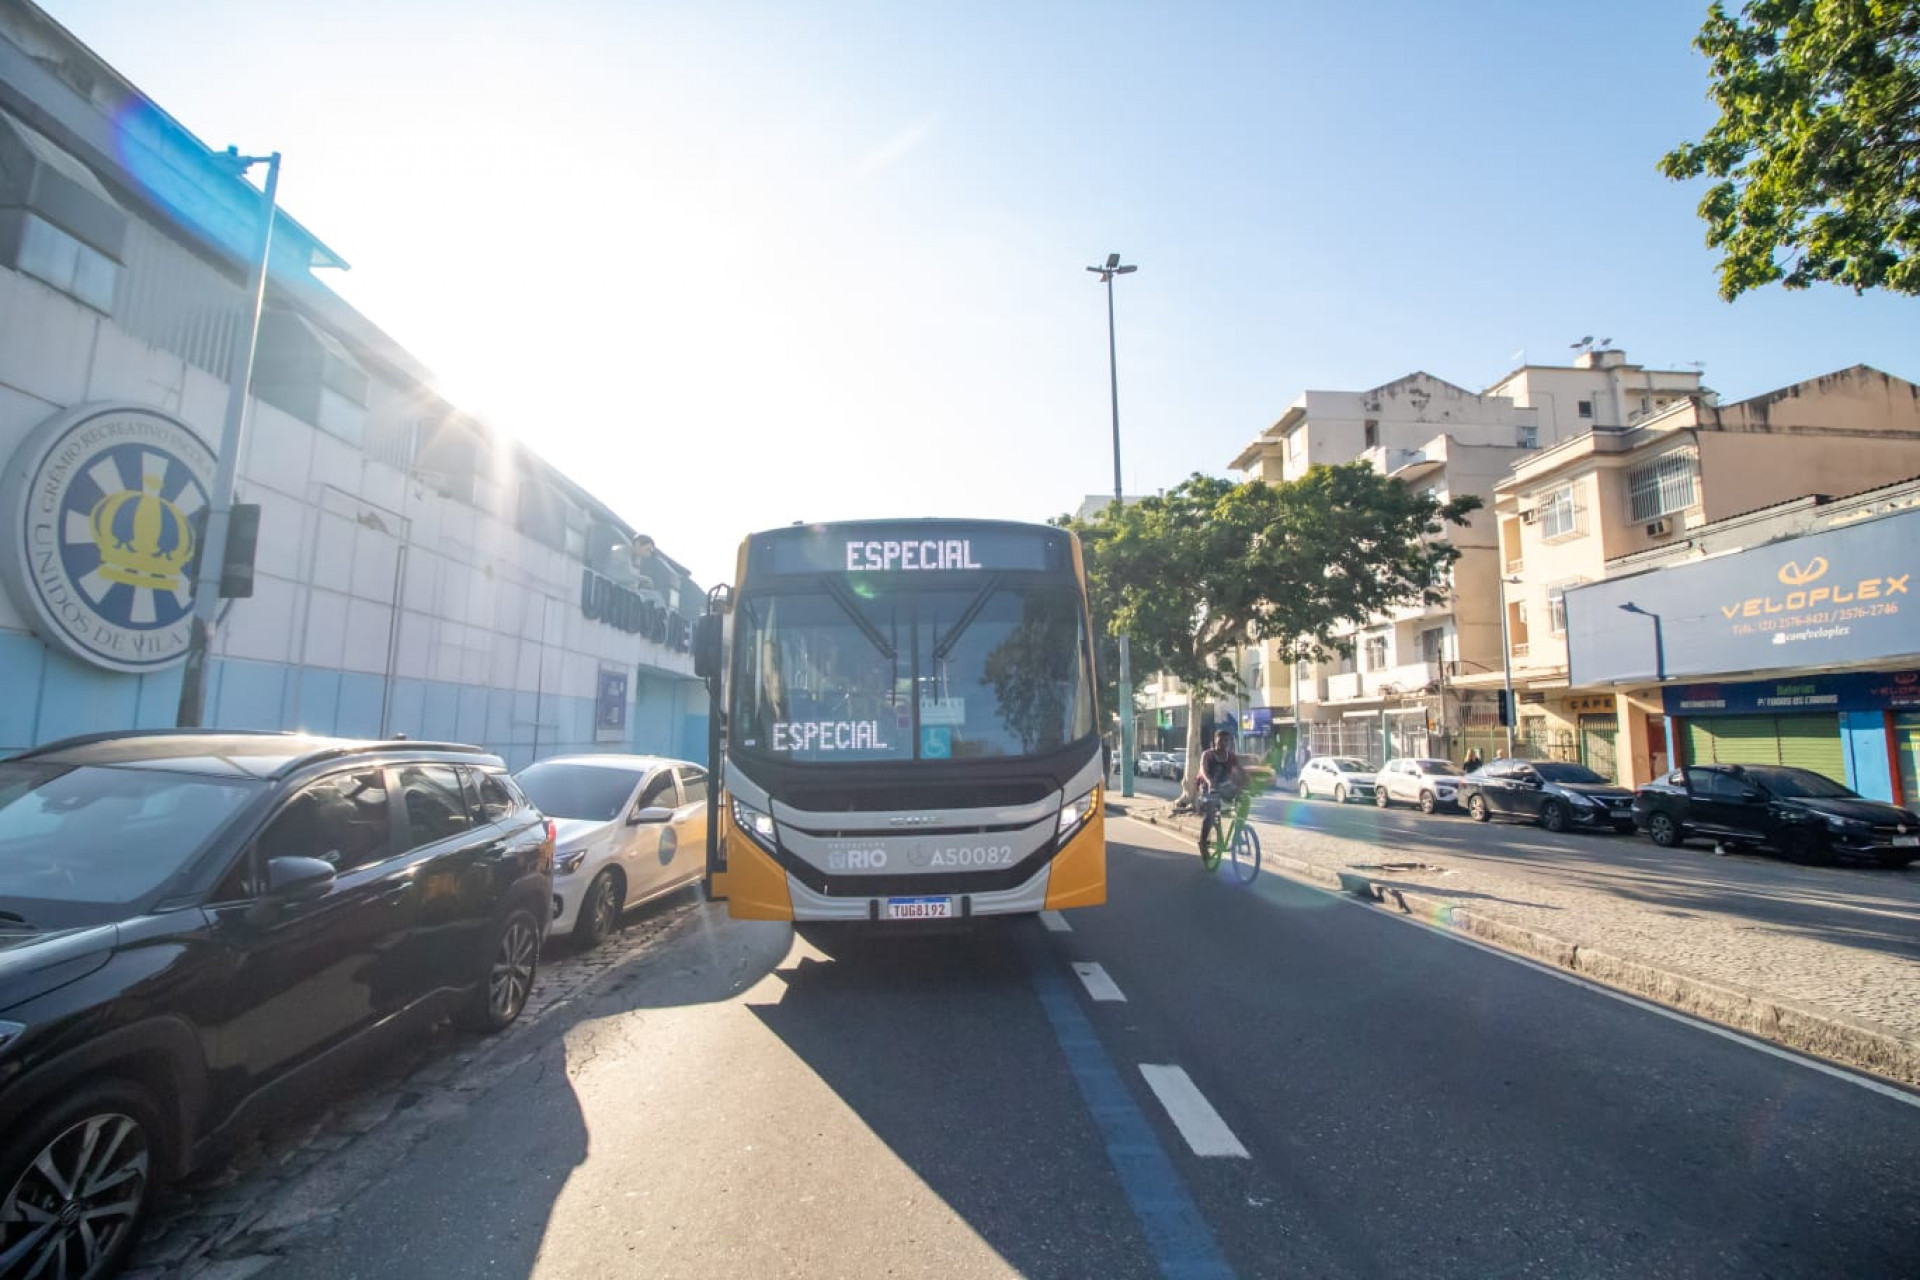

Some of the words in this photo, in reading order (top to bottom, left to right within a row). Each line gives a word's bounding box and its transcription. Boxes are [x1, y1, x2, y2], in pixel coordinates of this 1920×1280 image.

[846, 539, 981, 571] ESPECIAL
[35, 524, 92, 634] UNIDOS
[93, 631, 123, 650] DE
[1721, 574, 1910, 619] VELOPLEX
[773, 720, 888, 751] ESPECIAL
[848, 849, 887, 869] RIO
[931, 845, 1012, 866] A50082
